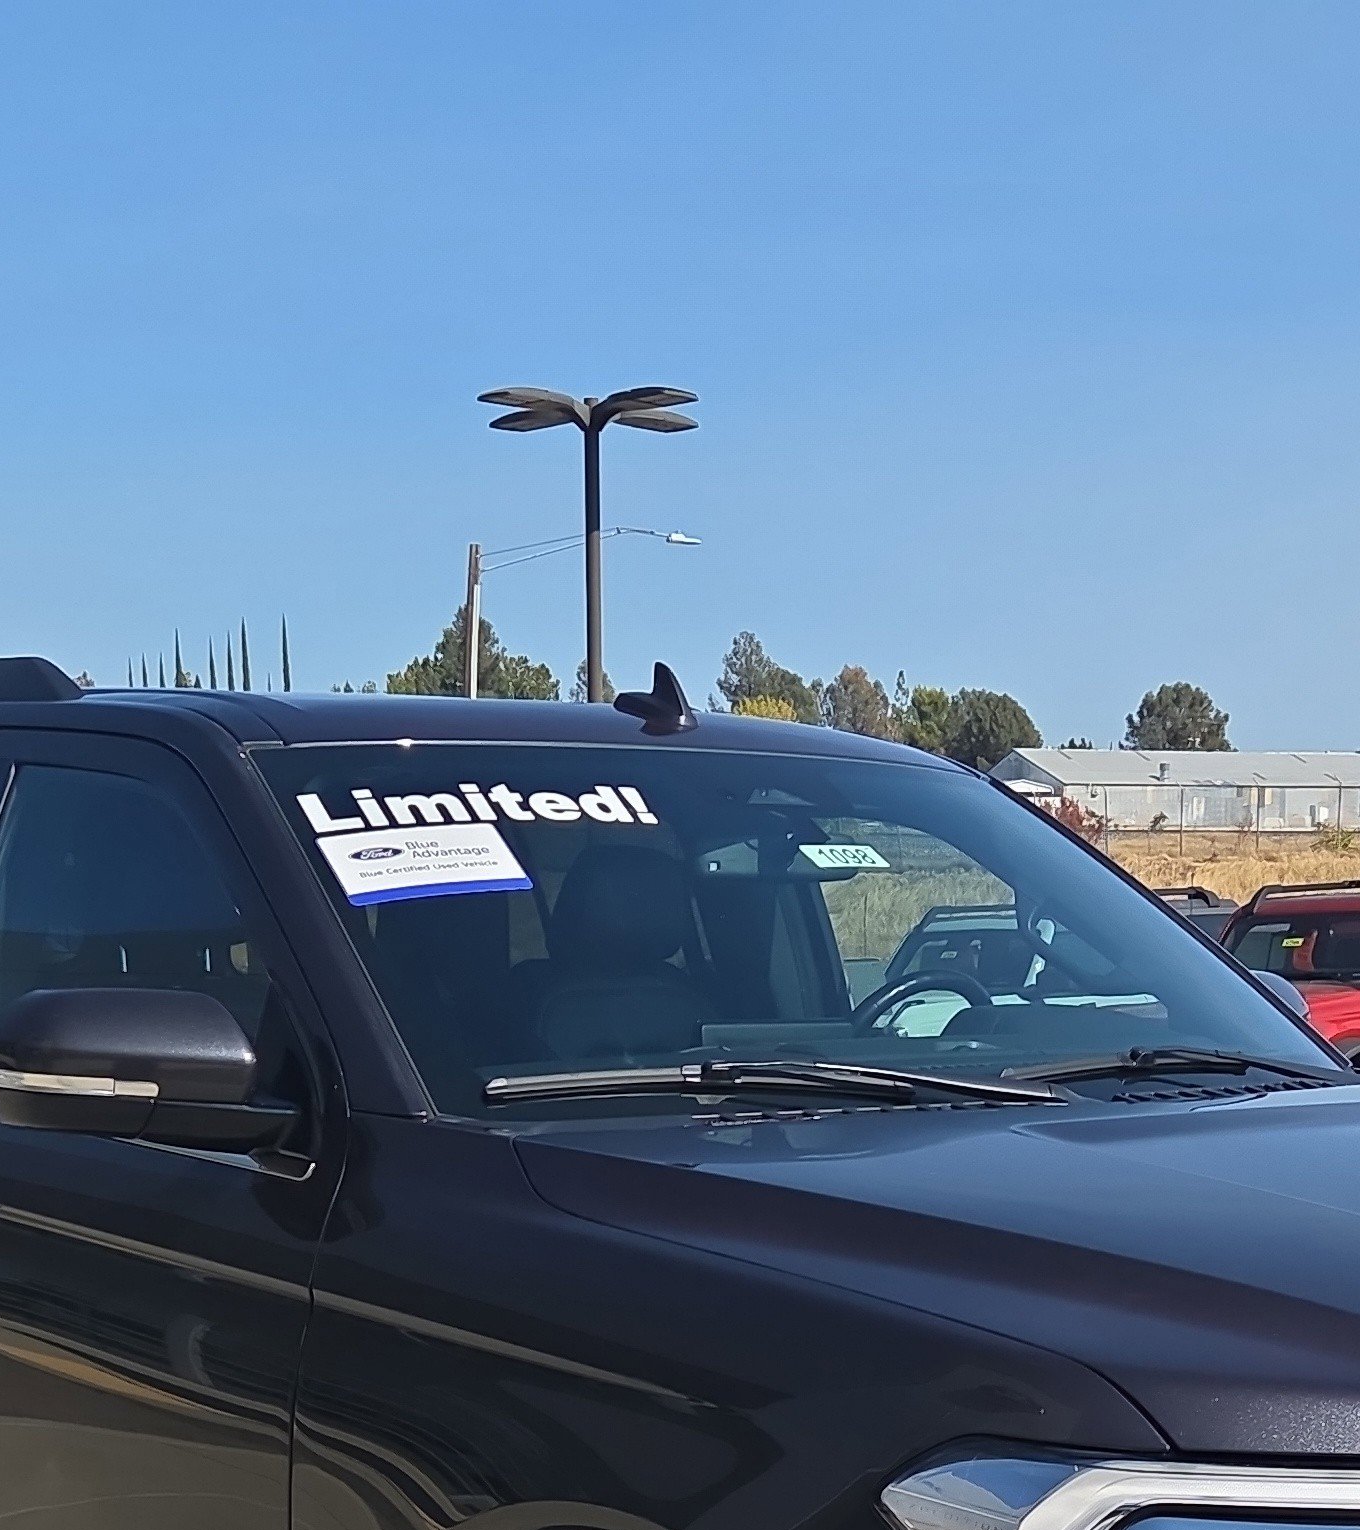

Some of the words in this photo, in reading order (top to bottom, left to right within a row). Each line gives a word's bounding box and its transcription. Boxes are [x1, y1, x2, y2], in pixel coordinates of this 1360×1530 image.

[296, 783, 660, 833] Limited!
[405, 841, 440, 850] Blue
[412, 845, 491, 860] Advantage
[818, 848, 877, 865] 1098
[359, 870, 384, 879] Blue
[386, 863, 431, 875] Certified
[433, 861, 460, 870] Used
[462, 860, 499, 868] Vehicle
